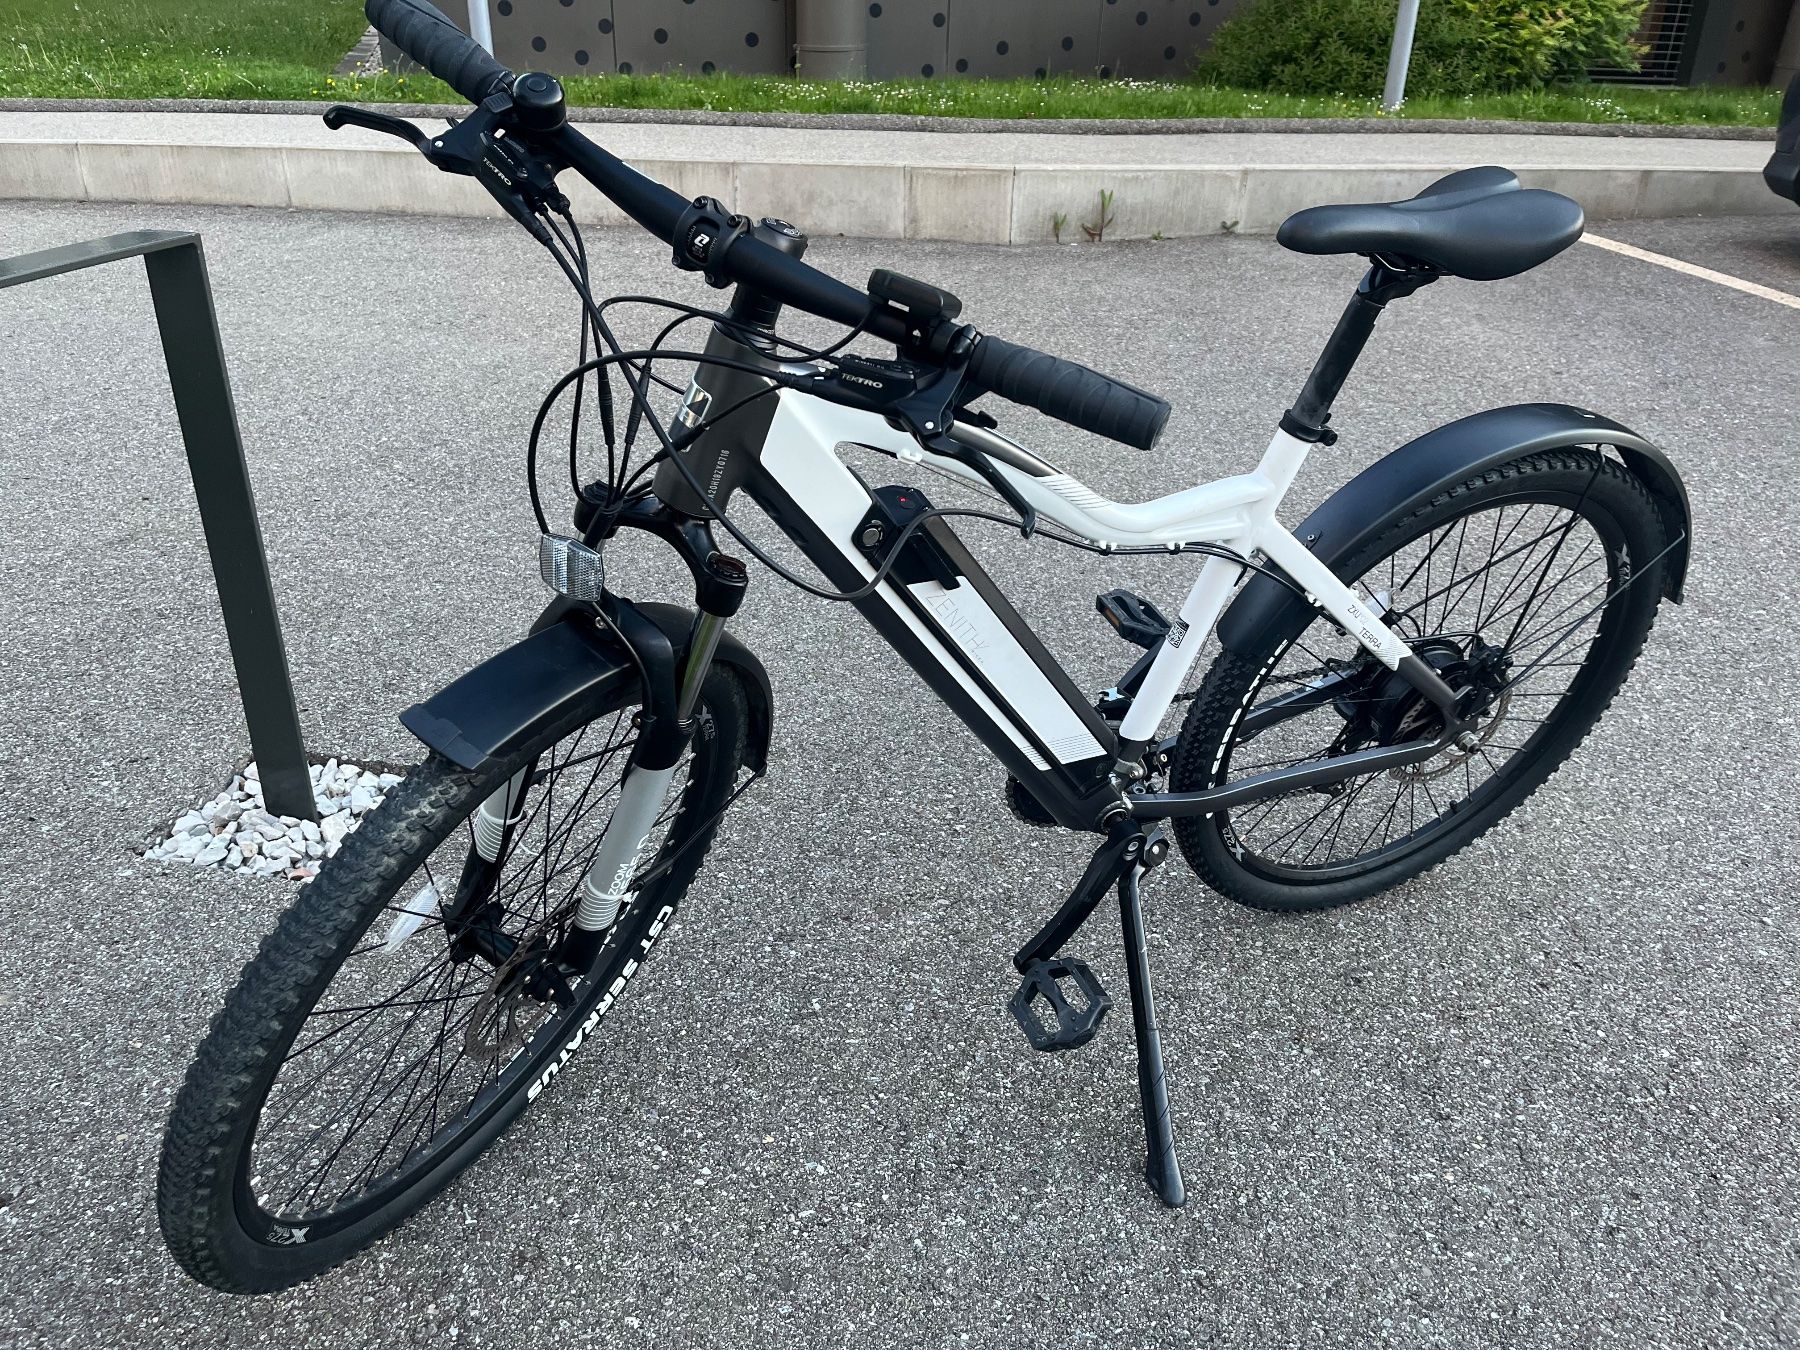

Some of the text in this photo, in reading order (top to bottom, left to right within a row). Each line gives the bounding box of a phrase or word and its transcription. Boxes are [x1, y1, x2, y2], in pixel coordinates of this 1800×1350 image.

[483, 157, 512, 186] TEKTRO
[841, 373, 883, 389] TEKTRO
[1359, 626, 1382, 649] TERRA
[608, 863, 629, 896] ZOOM
[527, 905, 674, 1104] CST SERRATUS
